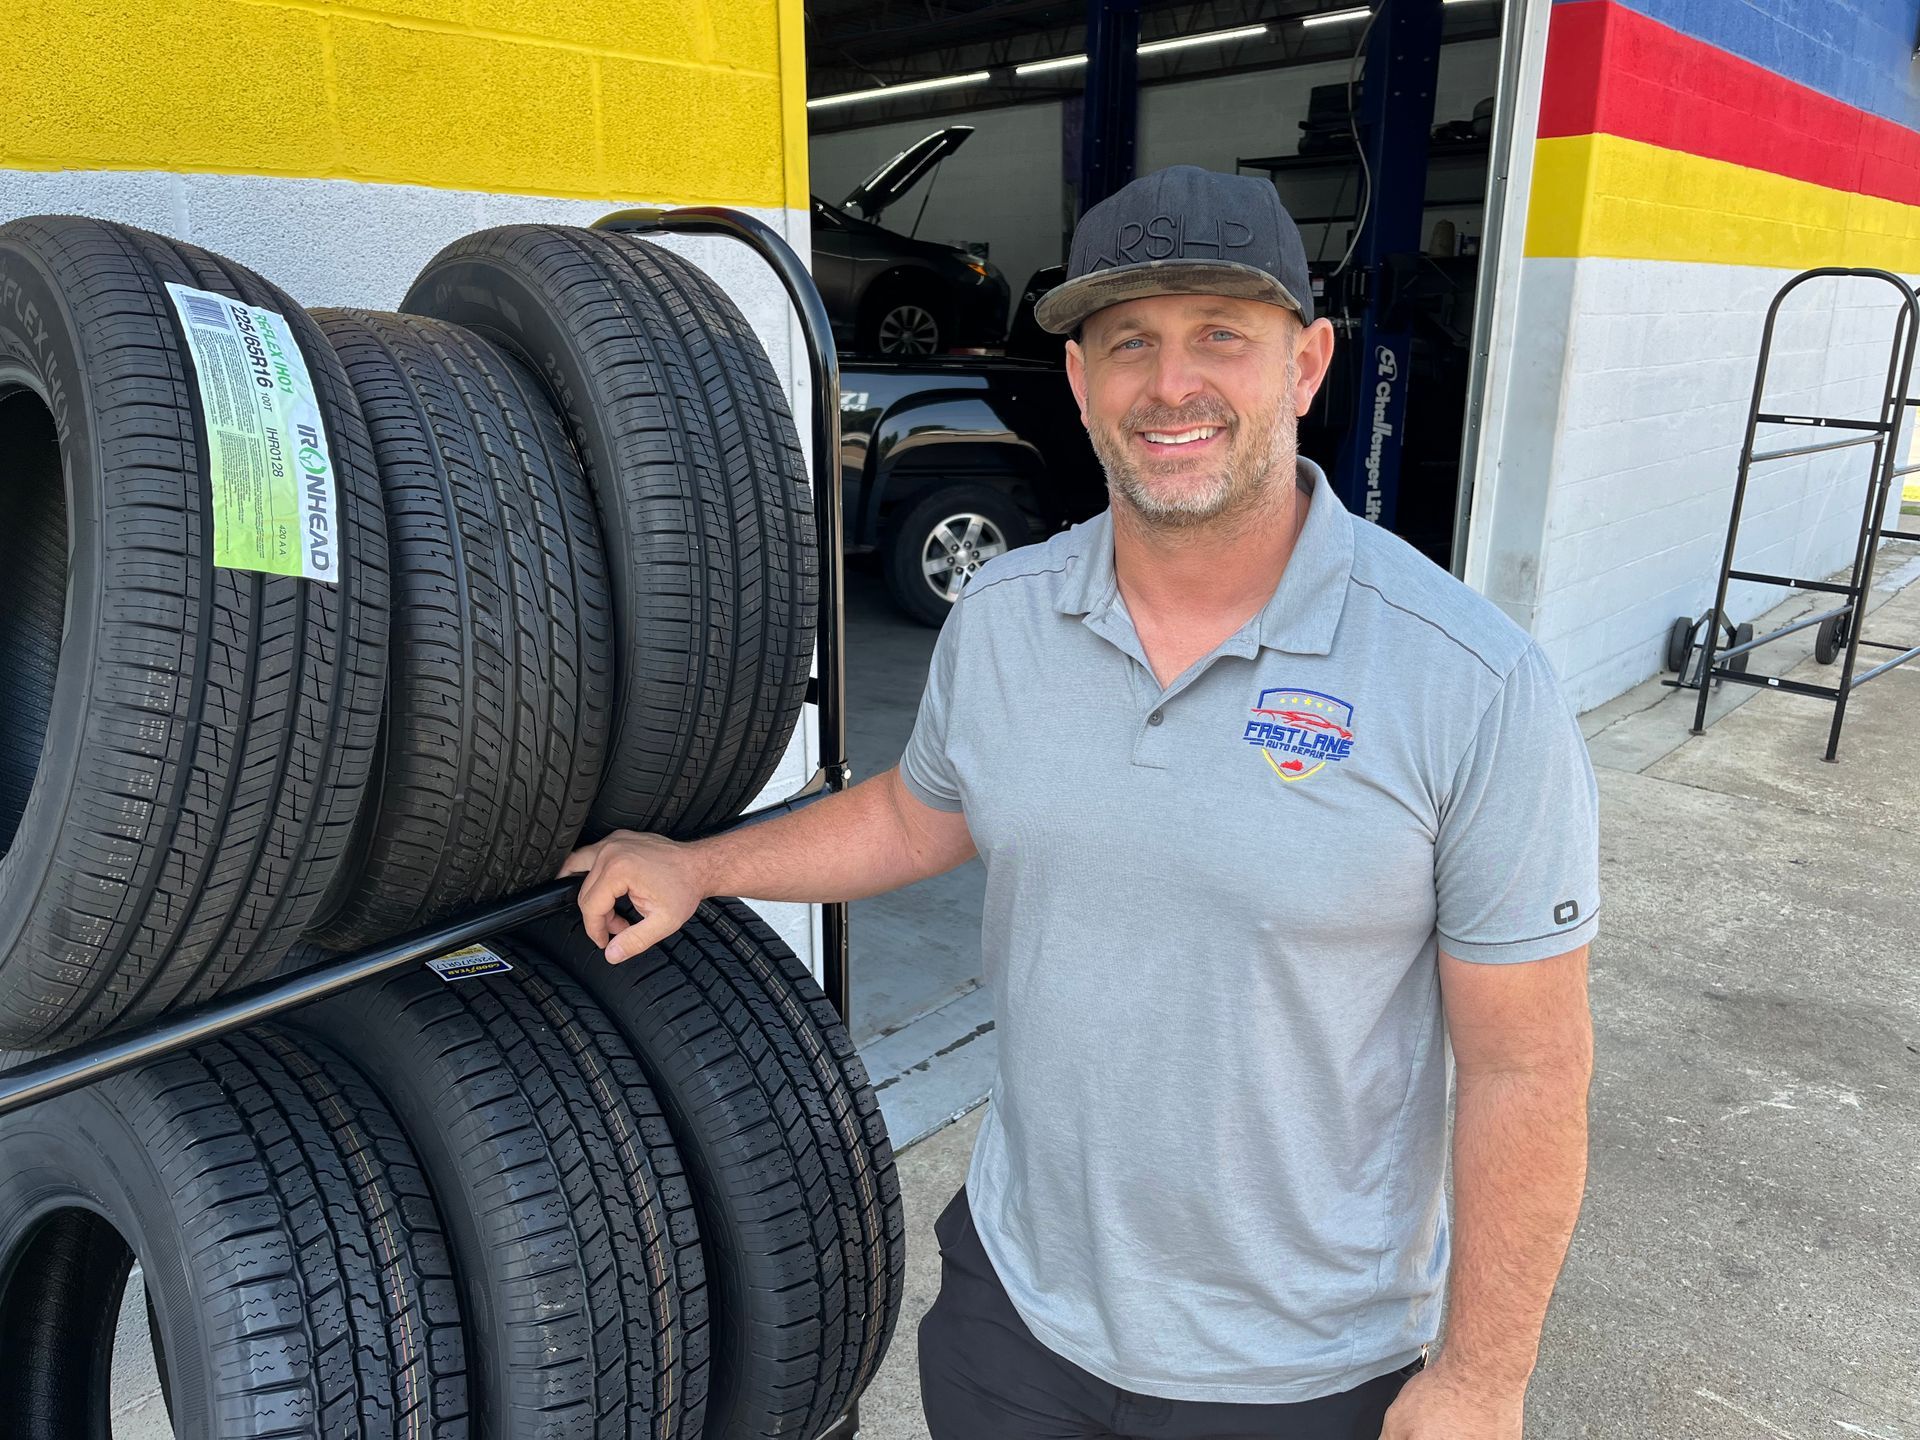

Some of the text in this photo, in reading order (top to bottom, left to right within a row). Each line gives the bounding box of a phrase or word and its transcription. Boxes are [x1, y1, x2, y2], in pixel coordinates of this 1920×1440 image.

[231, 306, 274, 413] 225/65R16 100T
[256, 313, 296, 395] REFLEX IH01
[840, 392, 869, 404] 71
[265, 427, 284, 478] IHR0128
[1364, 381, 1393, 489] Challenger
[296, 423, 329, 571] IRONHEAD
[278, 524, 288, 539] 420
[1244, 721, 1355, 755] FAST LANE
[1265, 740, 1326, 760] AUTO REPAIR
